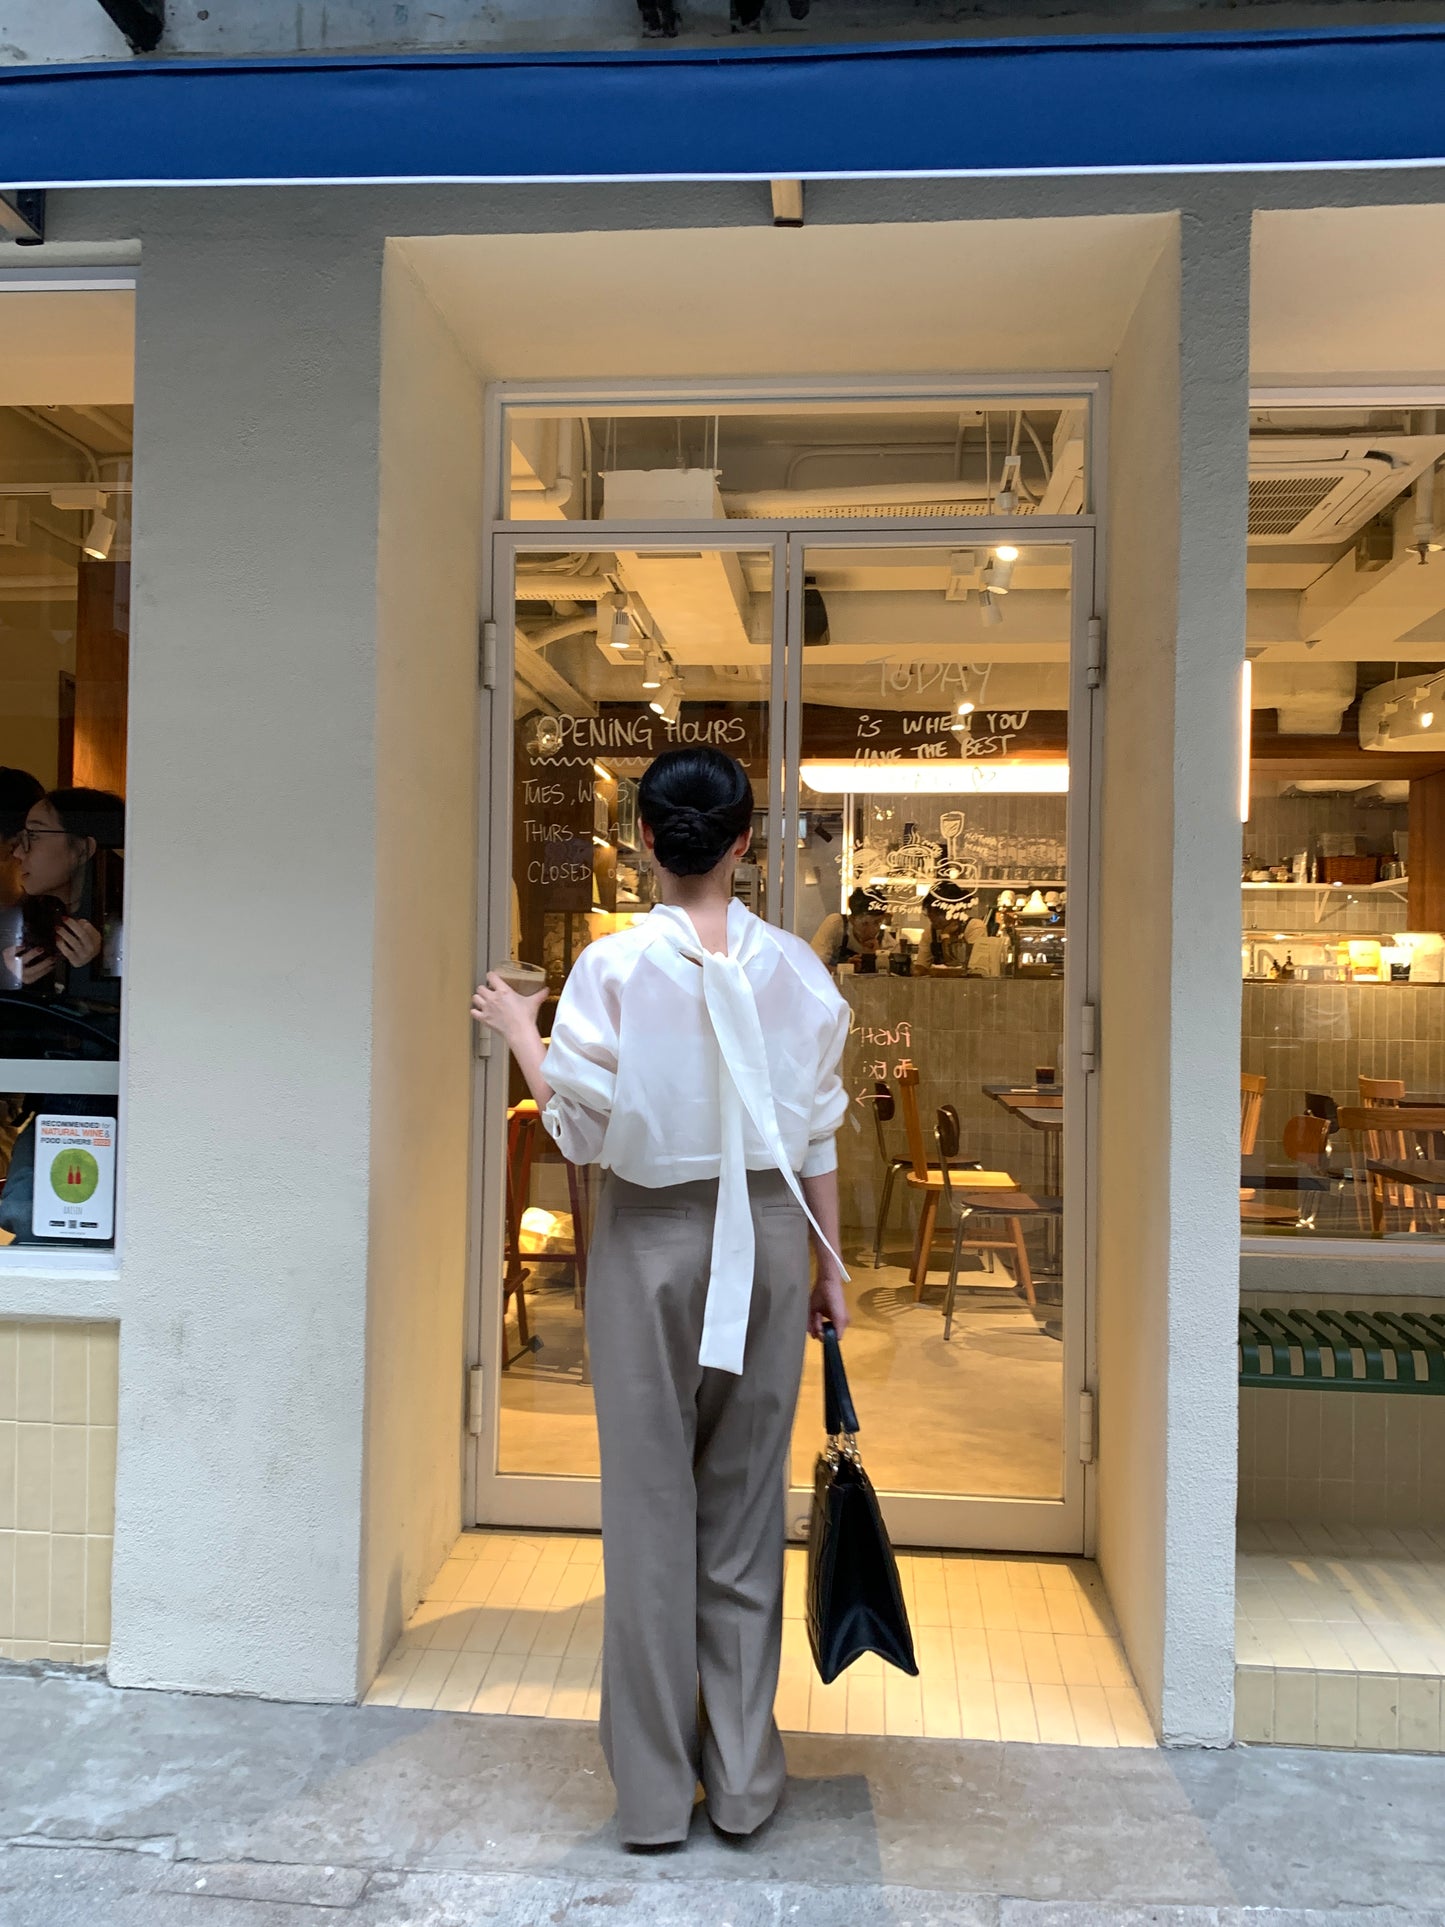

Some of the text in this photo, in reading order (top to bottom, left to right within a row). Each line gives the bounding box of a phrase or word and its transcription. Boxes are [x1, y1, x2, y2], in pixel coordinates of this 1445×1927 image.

[864, 654, 993, 704] TODAY
[664, 710, 746, 744] HOURS
[902, 714, 972, 735] WHEN
[986, 710, 1029, 733] YOU
[853, 733, 1017, 768] HAVE THE BEST
[522, 819, 574, 843] THURS
[527, 860, 591, 885] CLOSED
[41, 1120, 99, 1128] RECOMMENDED
[41, 1128, 80, 1137] NATURAL
[82, 1129, 103, 1137] WINE
